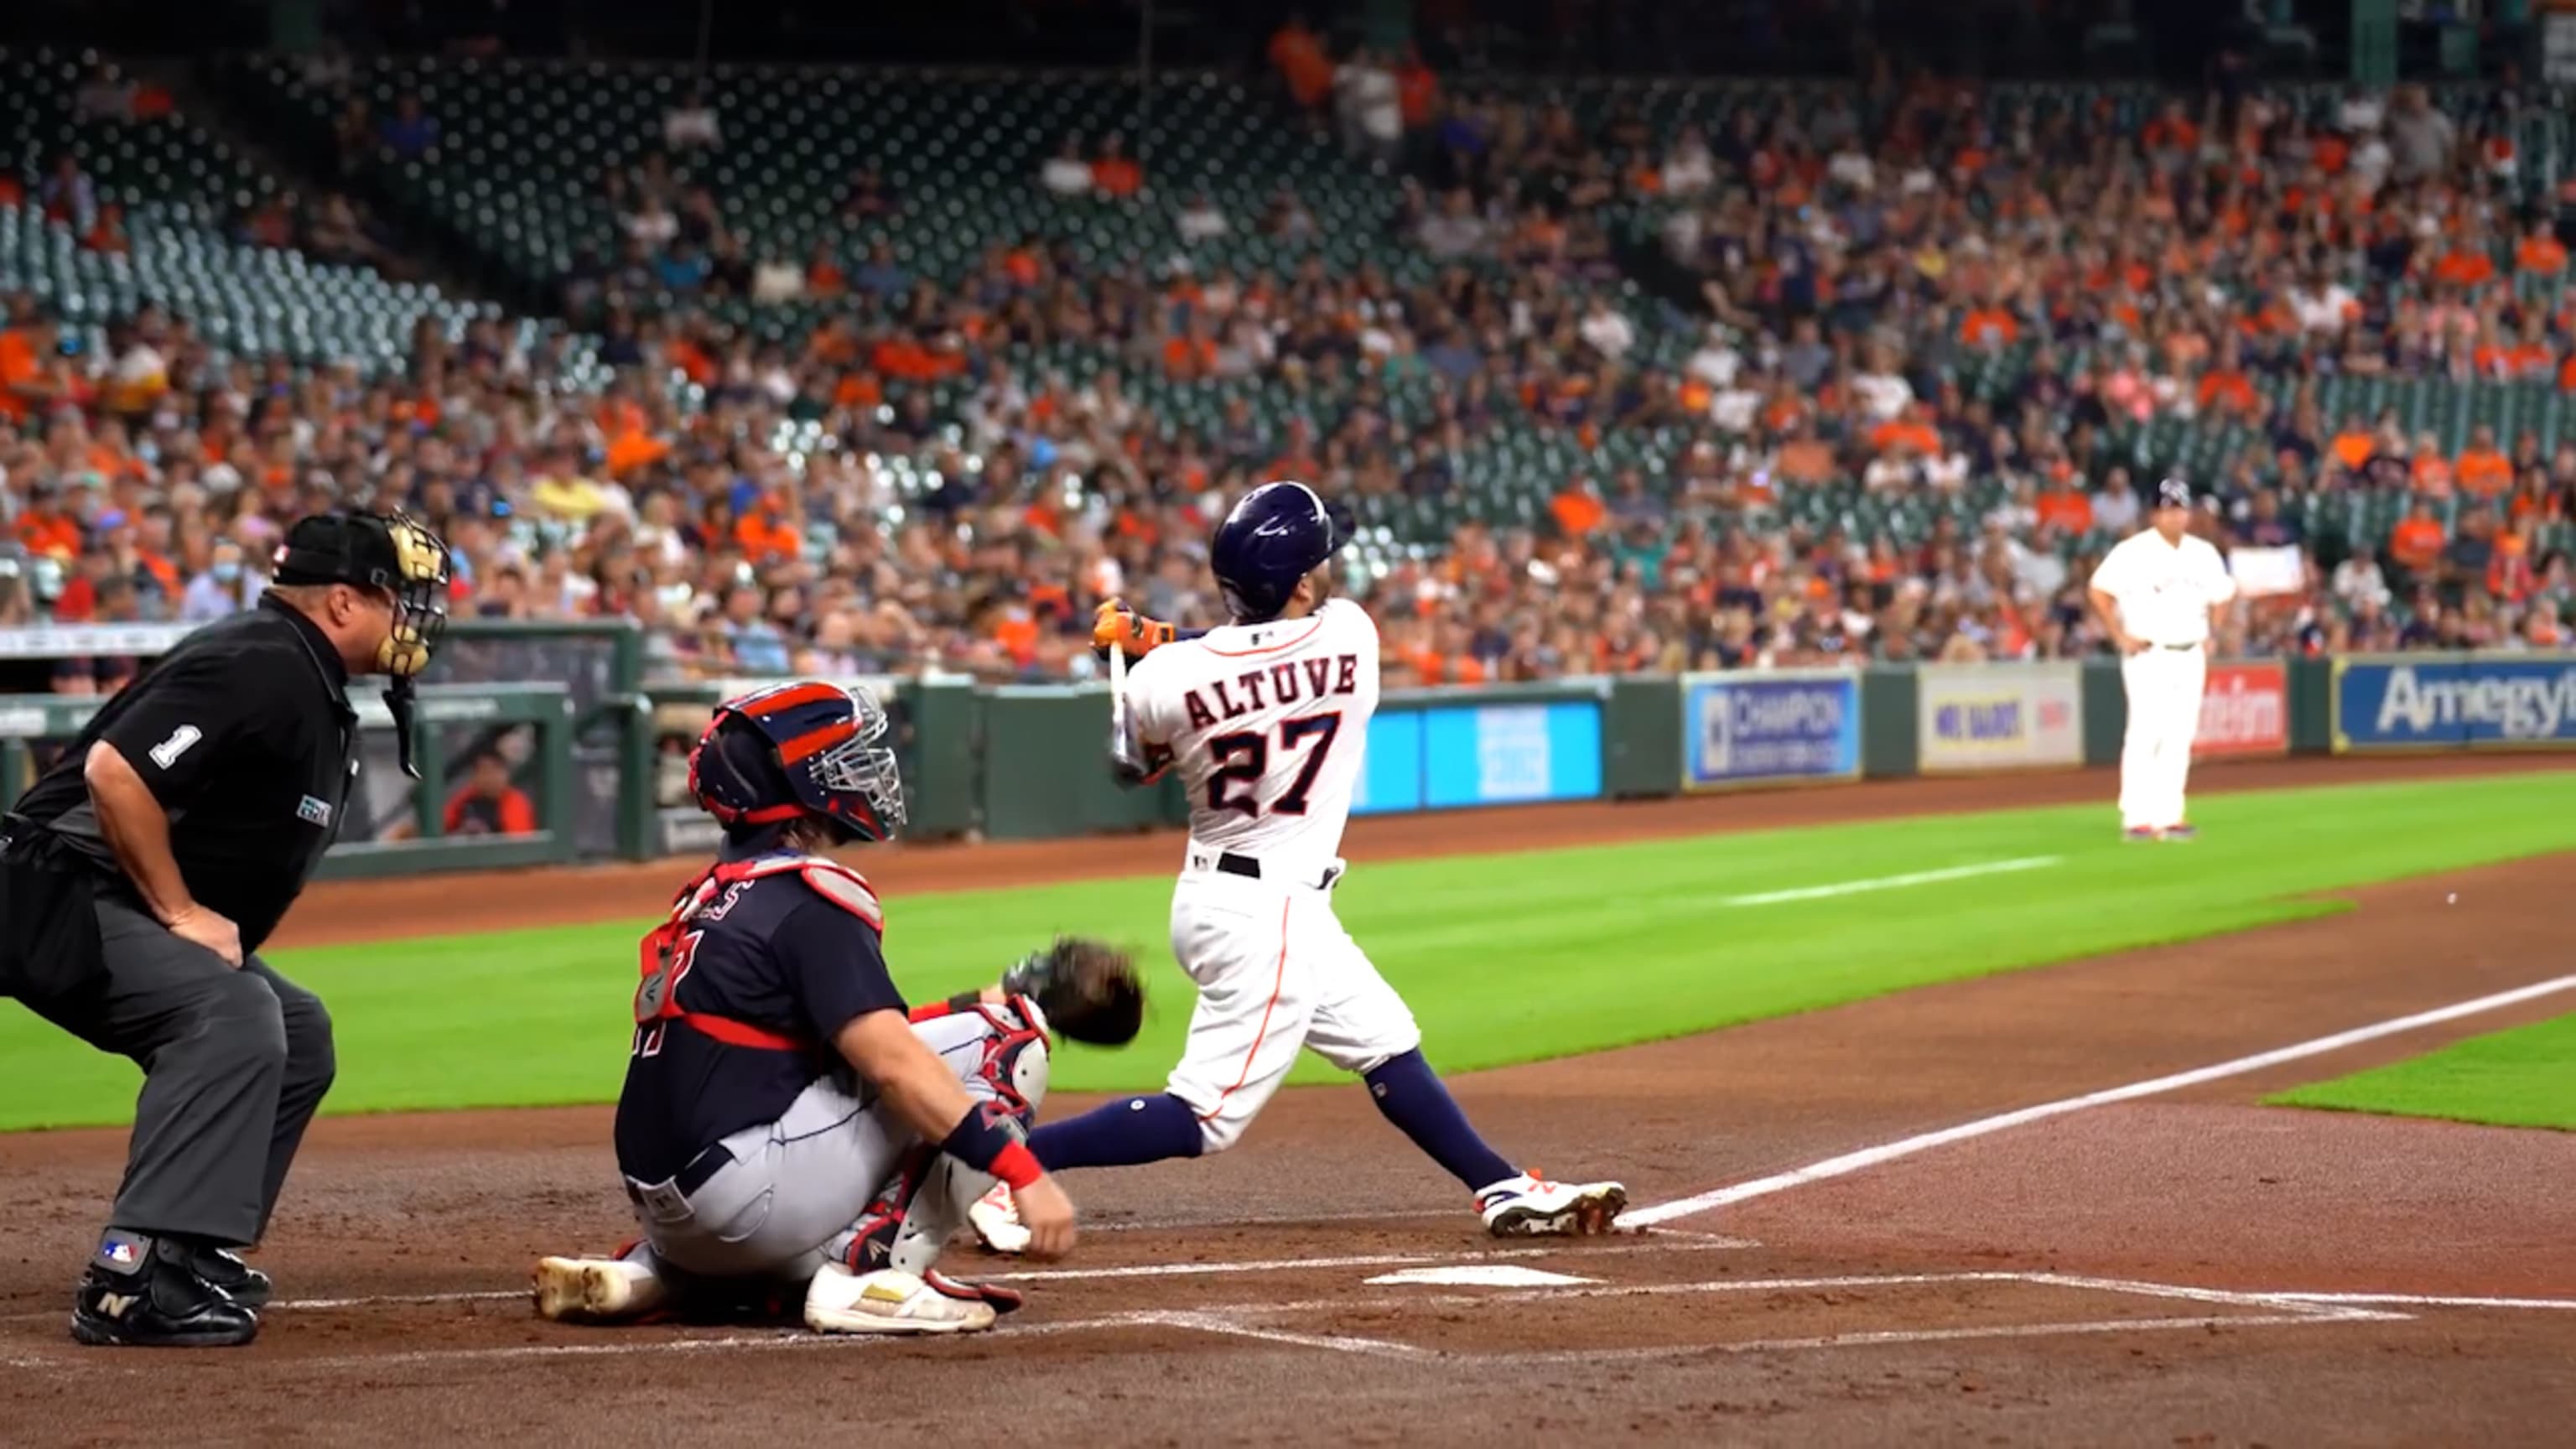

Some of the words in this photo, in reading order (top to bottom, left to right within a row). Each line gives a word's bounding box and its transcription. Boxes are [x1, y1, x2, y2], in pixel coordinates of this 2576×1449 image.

[1184, 653, 1358, 732] ALTUVE
[148, 724, 203, 770] 1
[1207, 710, 1343, 818] 27
